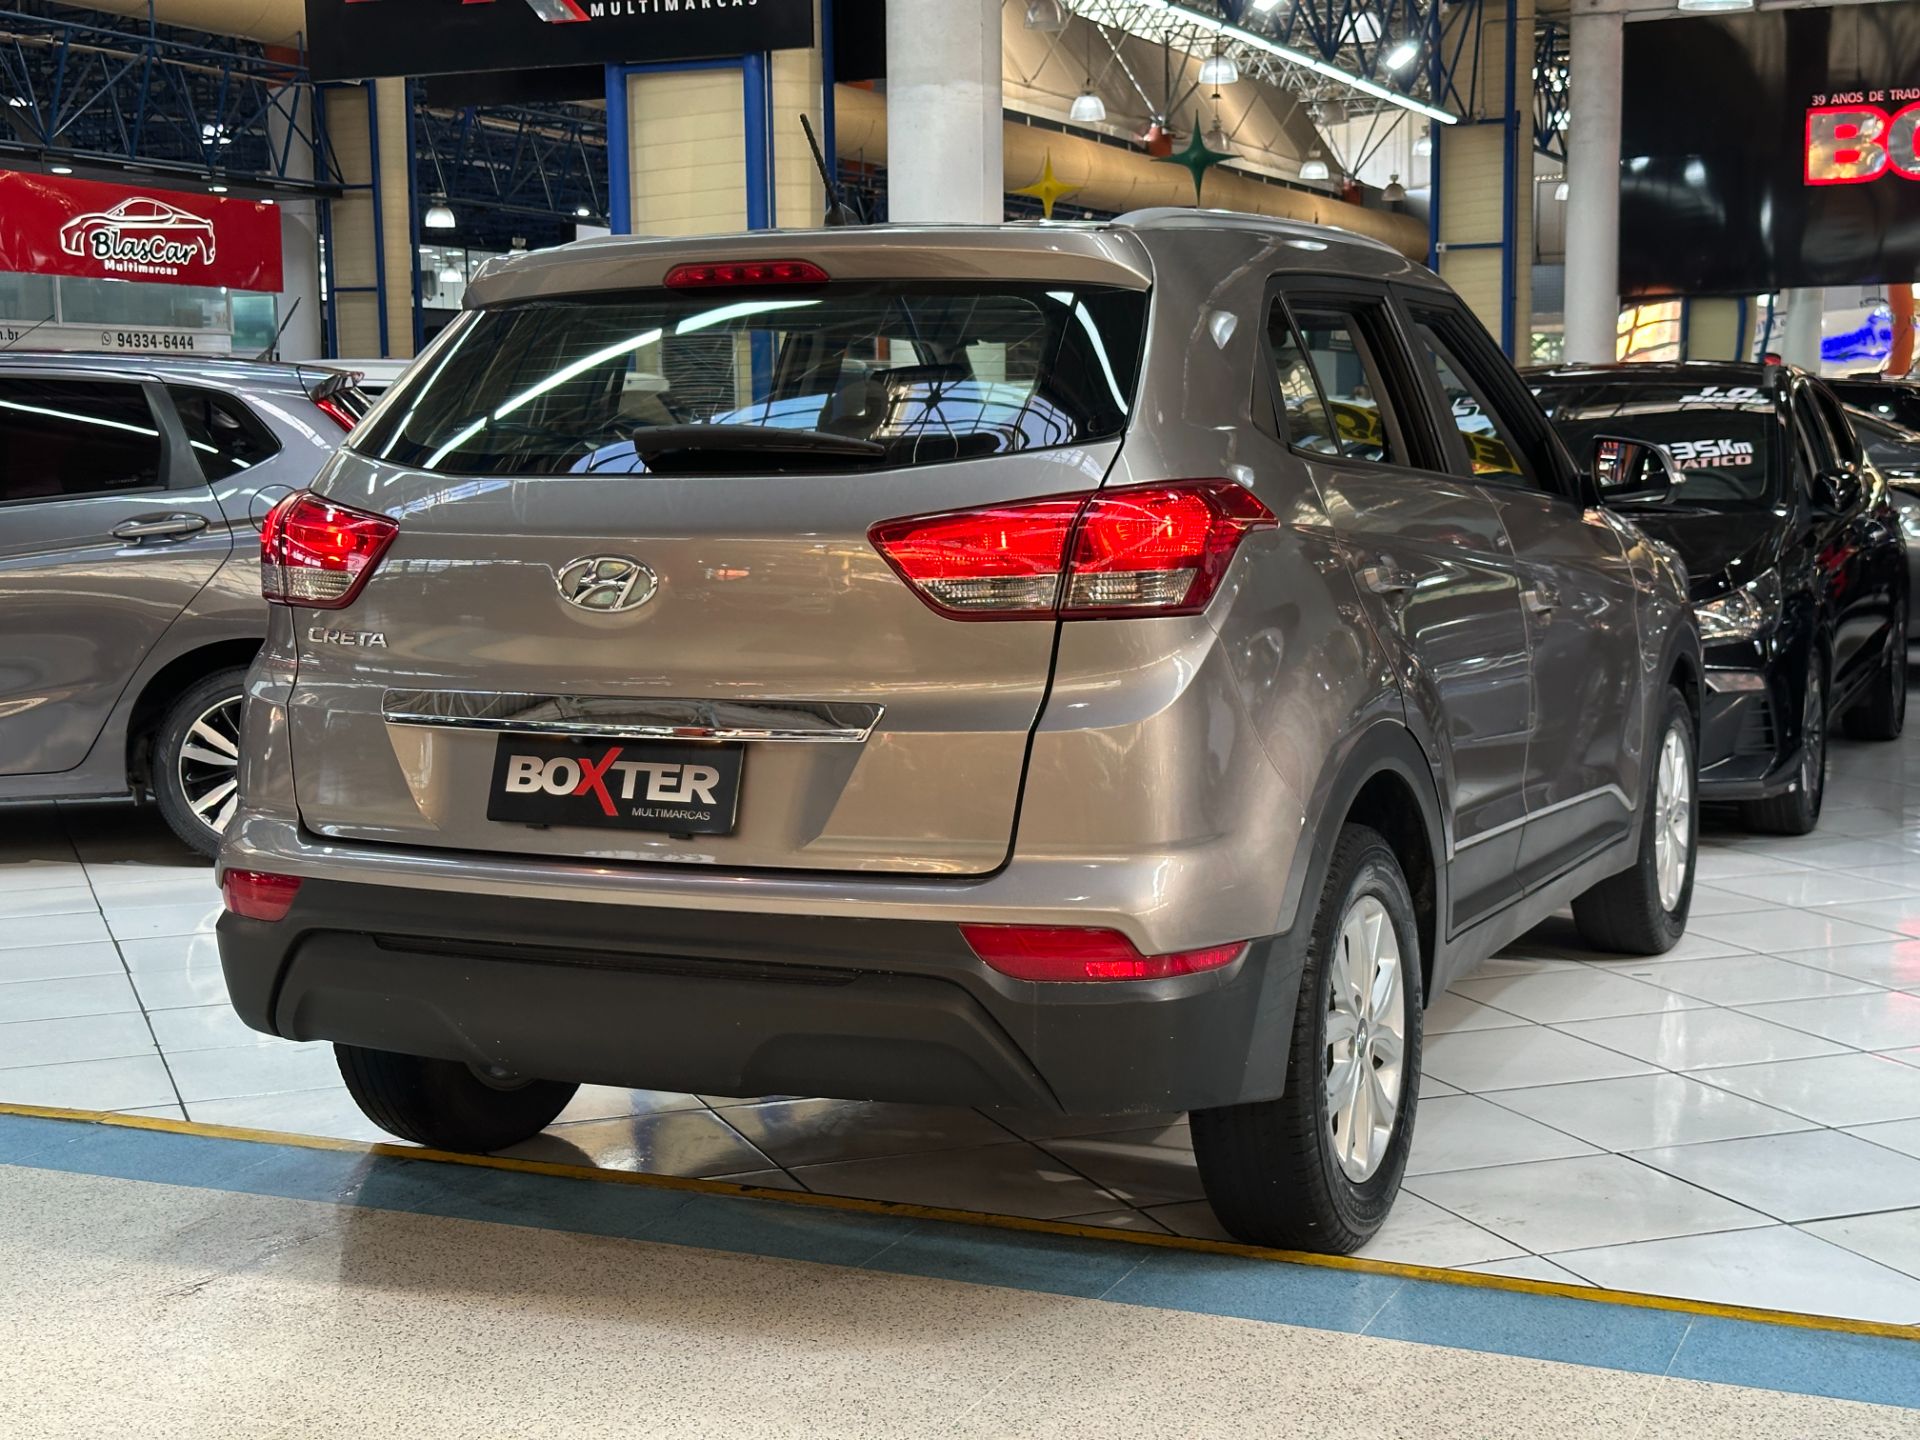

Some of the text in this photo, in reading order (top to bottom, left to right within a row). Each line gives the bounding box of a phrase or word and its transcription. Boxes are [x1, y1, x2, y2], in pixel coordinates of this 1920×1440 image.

[1811, 94, 1826, 106] 39
[1830, 92, 1863, 104] ANOS
[1868, 90, 1884, 102] DE
[90, 227, 198, 265] BlasCar
[104, 259, 178, 275] Multimarcas
[117, 332, 194, 350] 94334-6444
[307, 626, 389, 648] CRETA
[505, 747, 720, 817] BOXTER
[632, 807, 711, 821] MULTIMARCAS
